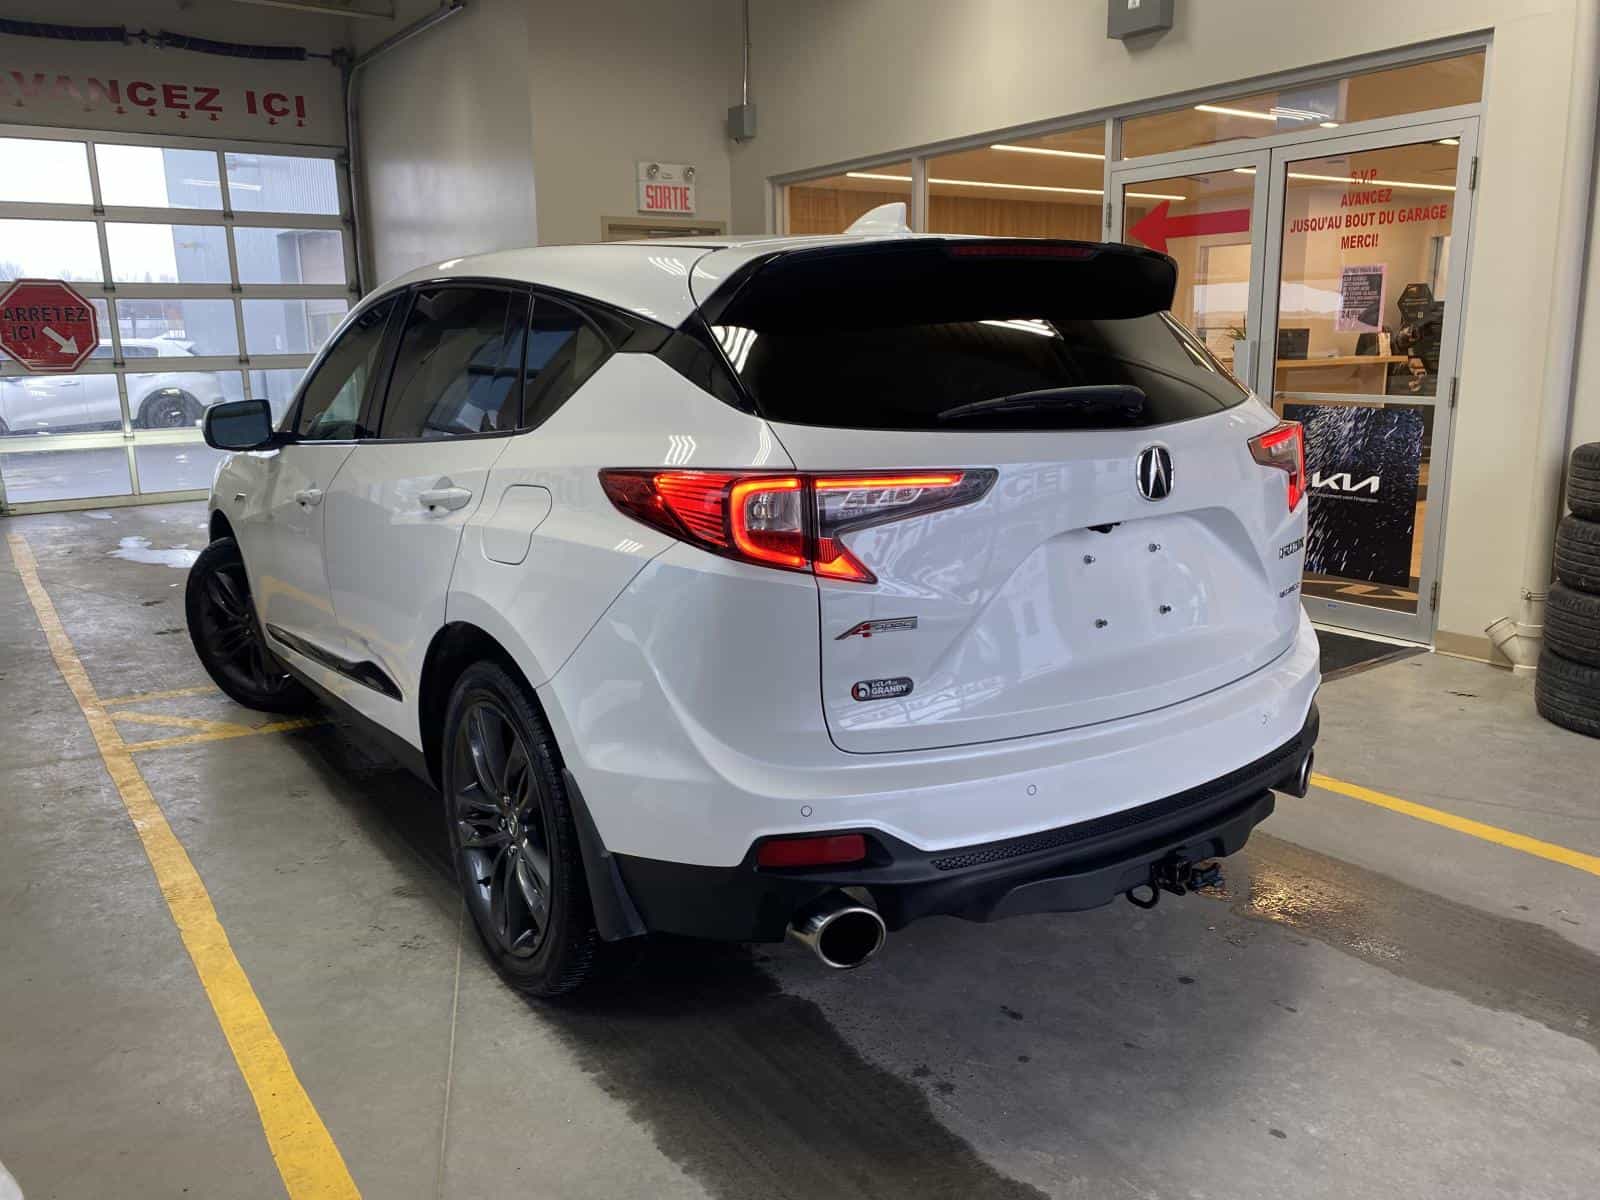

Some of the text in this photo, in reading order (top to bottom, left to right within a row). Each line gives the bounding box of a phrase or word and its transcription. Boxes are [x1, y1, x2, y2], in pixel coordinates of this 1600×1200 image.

[645, 184, 691, 211] SORTIE
[1340, 188, 1393, 208] AVANCEZ
[1290, 204, 1448, 233] JUSQU'AU BOUT DU GARAGE
[1341, 233, 1379, 249] MERCI!
[12, 325, 36, 340] ICI
[1311, 471, 1380, 494] KIA
[871, 683, 908, 695] GRANBY
